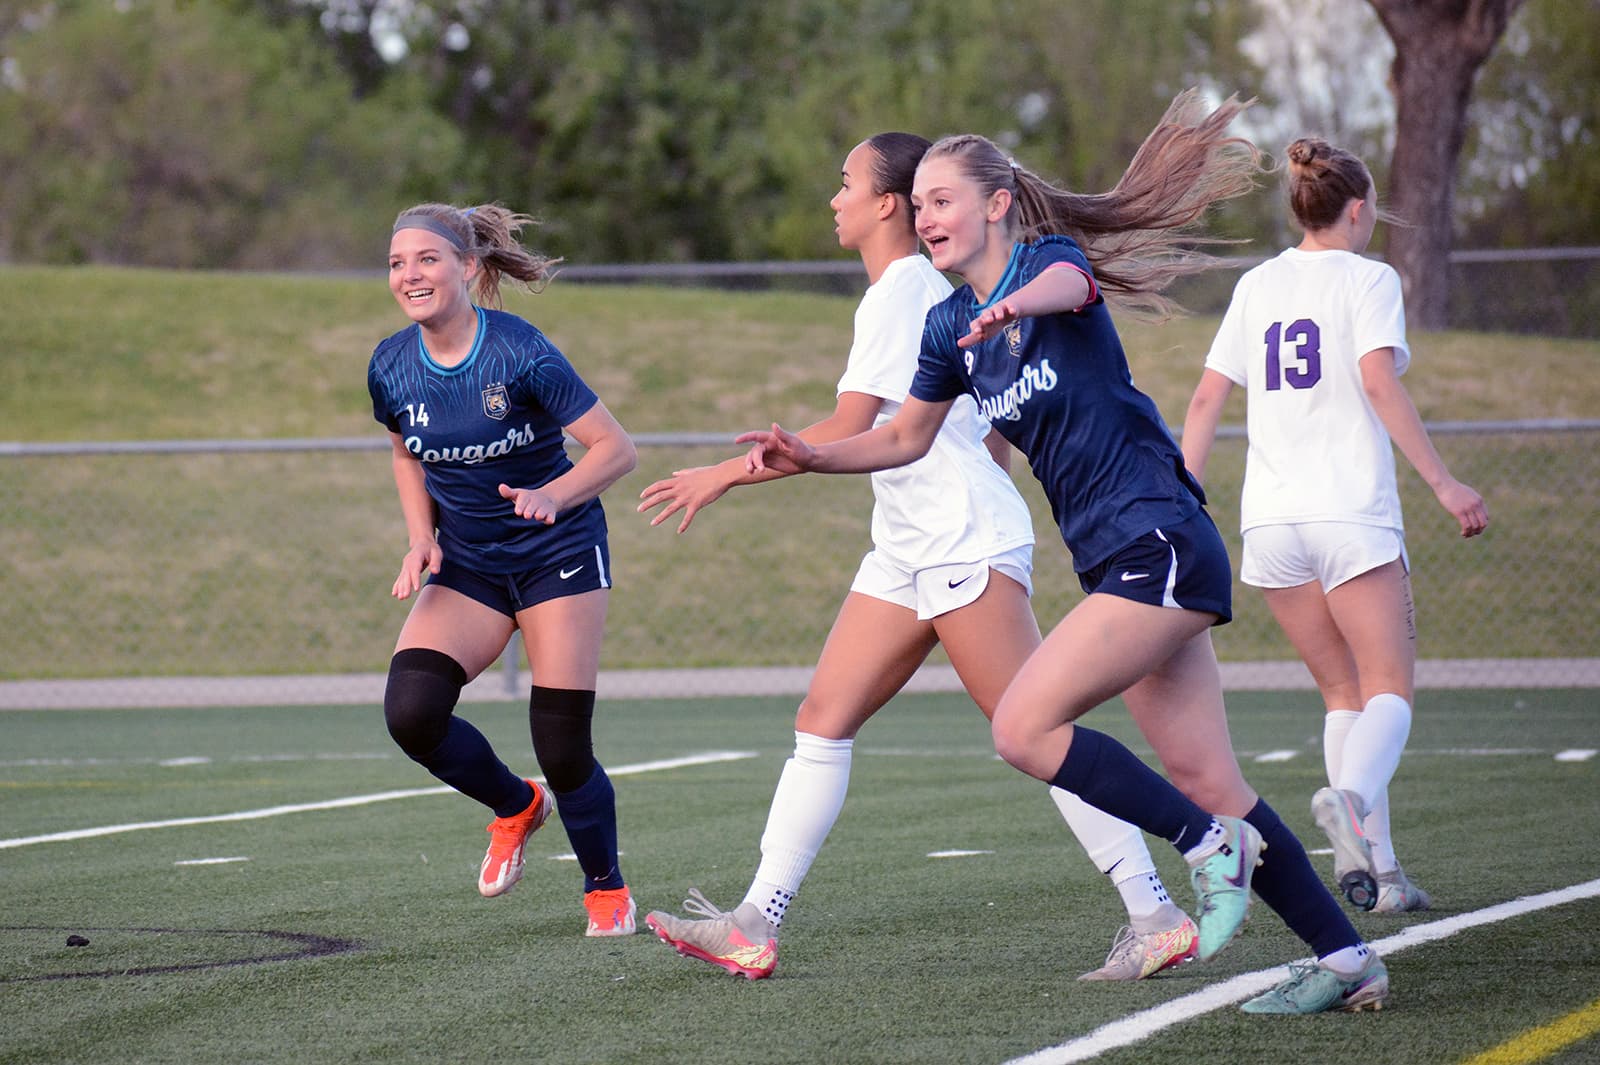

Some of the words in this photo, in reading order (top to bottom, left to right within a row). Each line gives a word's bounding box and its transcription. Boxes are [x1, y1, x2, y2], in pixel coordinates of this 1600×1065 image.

[964, 350, 974, 376] 9
[1264, 318, 1322, 391] 13
[973, 358, 1058, 421] ougars
[406, 403, 430, 427] 14
